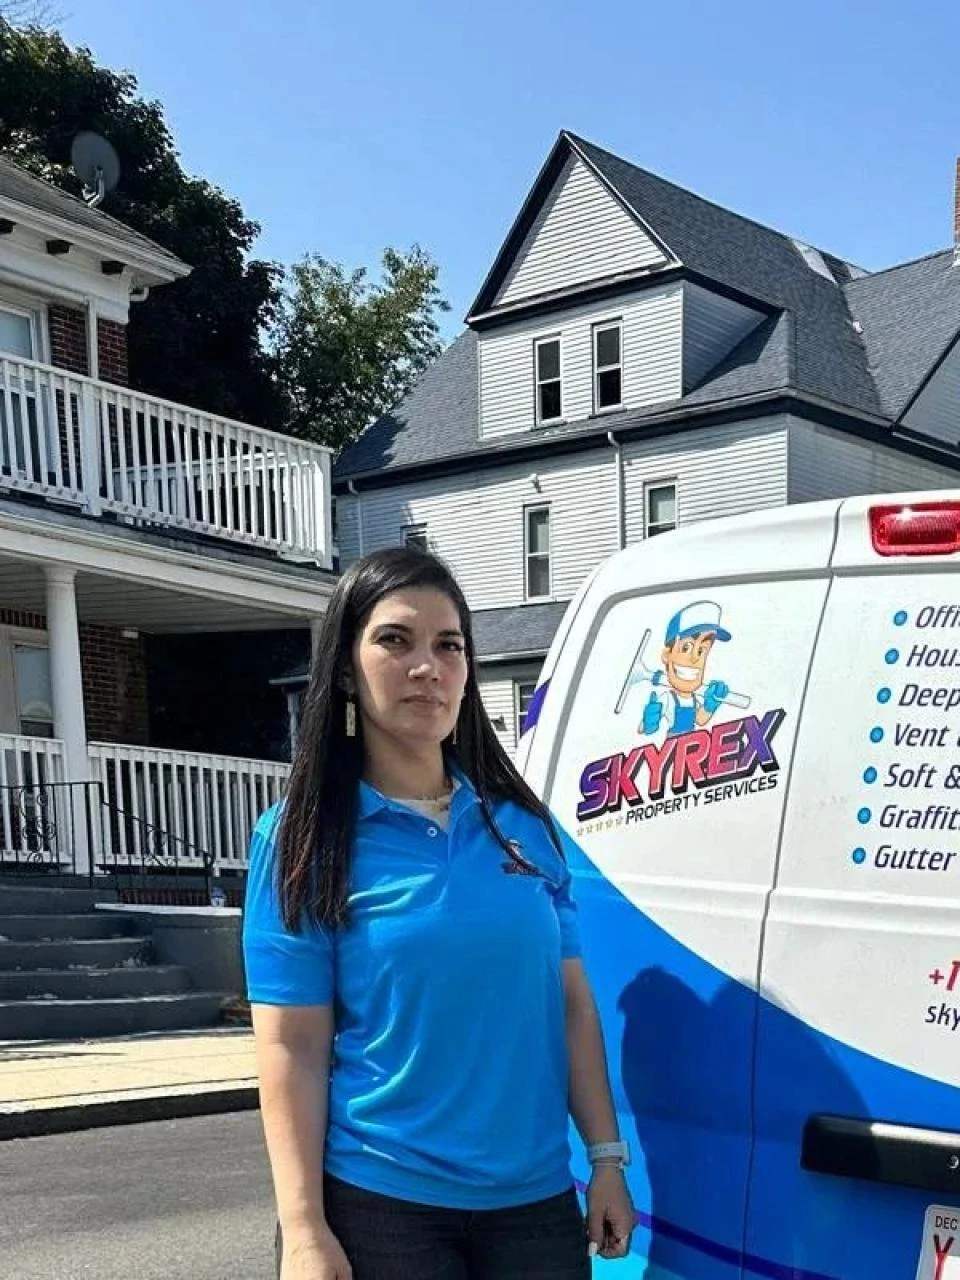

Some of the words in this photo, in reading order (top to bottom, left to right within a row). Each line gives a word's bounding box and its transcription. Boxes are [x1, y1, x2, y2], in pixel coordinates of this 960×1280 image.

[893, 723, 950, 747] Vent
[576, 707, 787, 822] SKYREX
[884, 763, 937, 789] Soft
[625, 792, 703, 824] PROPERTY
[704, 774, 778, 805] SERVICES
[874, 844, 956, 871] Gutter
[935, 1216, 958, 1231] DEC
